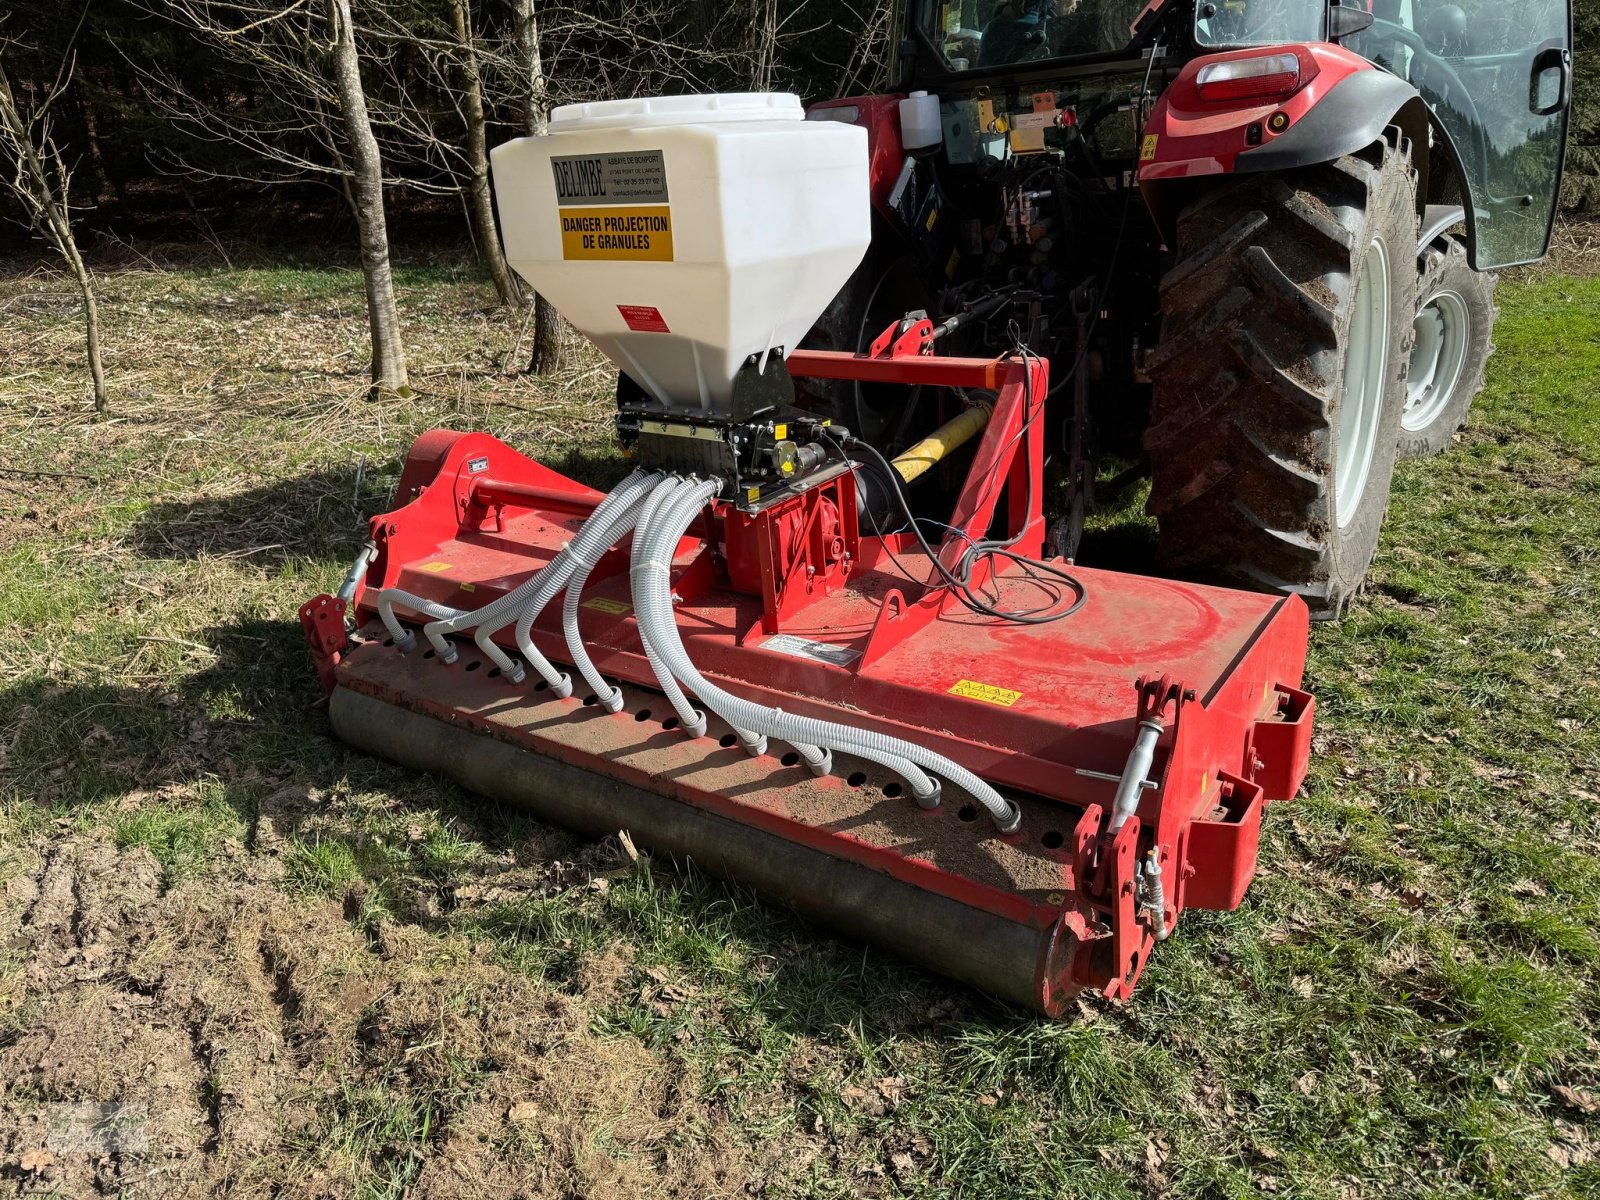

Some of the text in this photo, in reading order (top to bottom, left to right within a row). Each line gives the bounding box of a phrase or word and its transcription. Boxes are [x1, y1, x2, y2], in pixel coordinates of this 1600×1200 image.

[627, 156, 634, 164] DE
[553, 159, 606, 197] DELIMBE
[563, 216, 668, 232] DANGER PROJECTION
[583, 234, 650, 250] DE GRANULES
